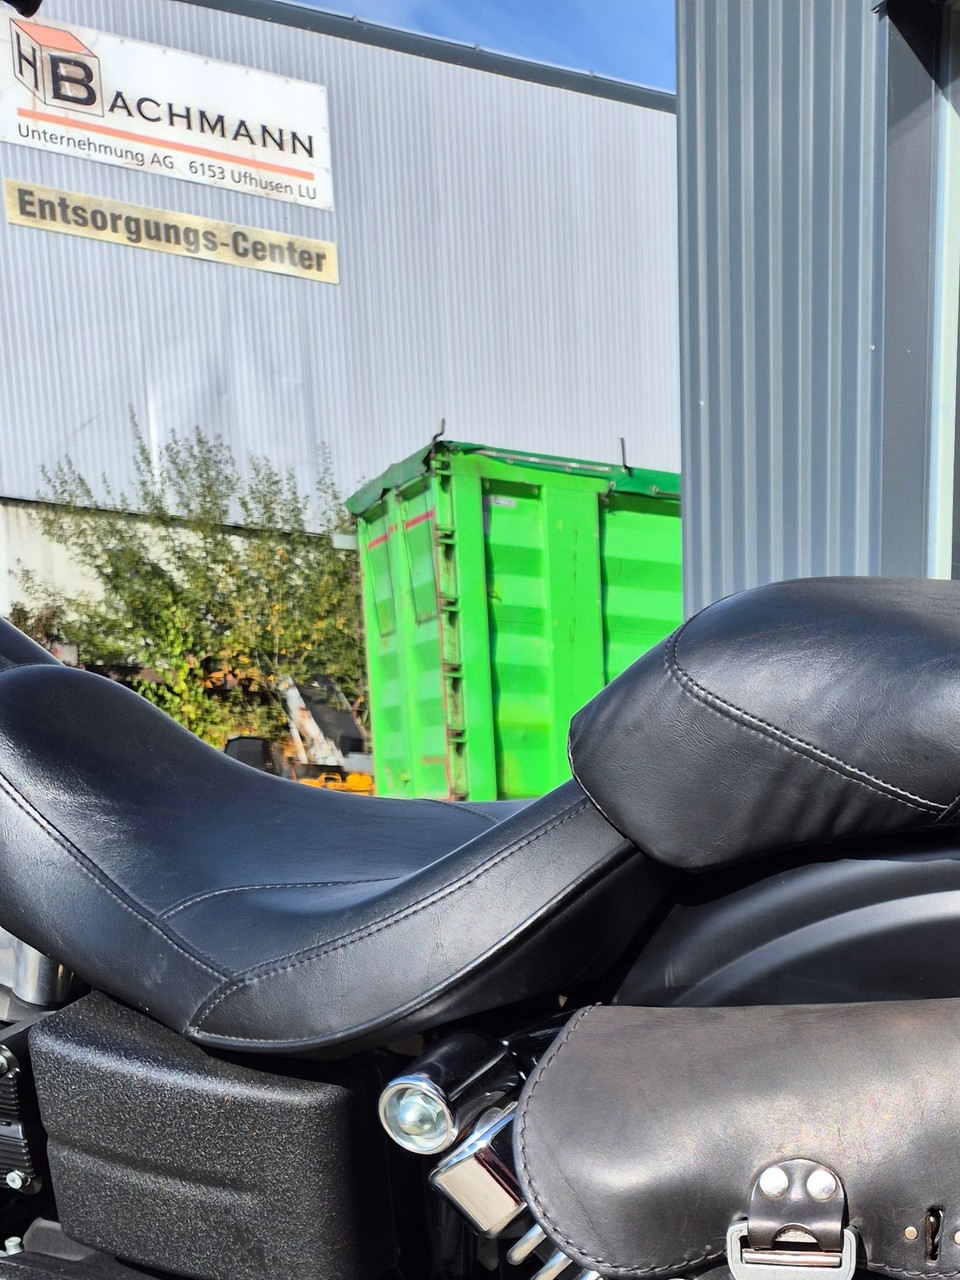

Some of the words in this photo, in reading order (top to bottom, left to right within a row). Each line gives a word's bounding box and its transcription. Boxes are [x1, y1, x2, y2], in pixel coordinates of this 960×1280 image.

[49, 54, 314, 158] BACHMANN
[18, 123, 145, 166] Unternehmung
[150, 152, 175, 170] AG
[189, 160, 226, 180] 6153
[231, 169, 294, 196] Ufhusen
[298, 183, 317, 200] LU
[17, 188, 327, 272] Entsorgungs-Center
